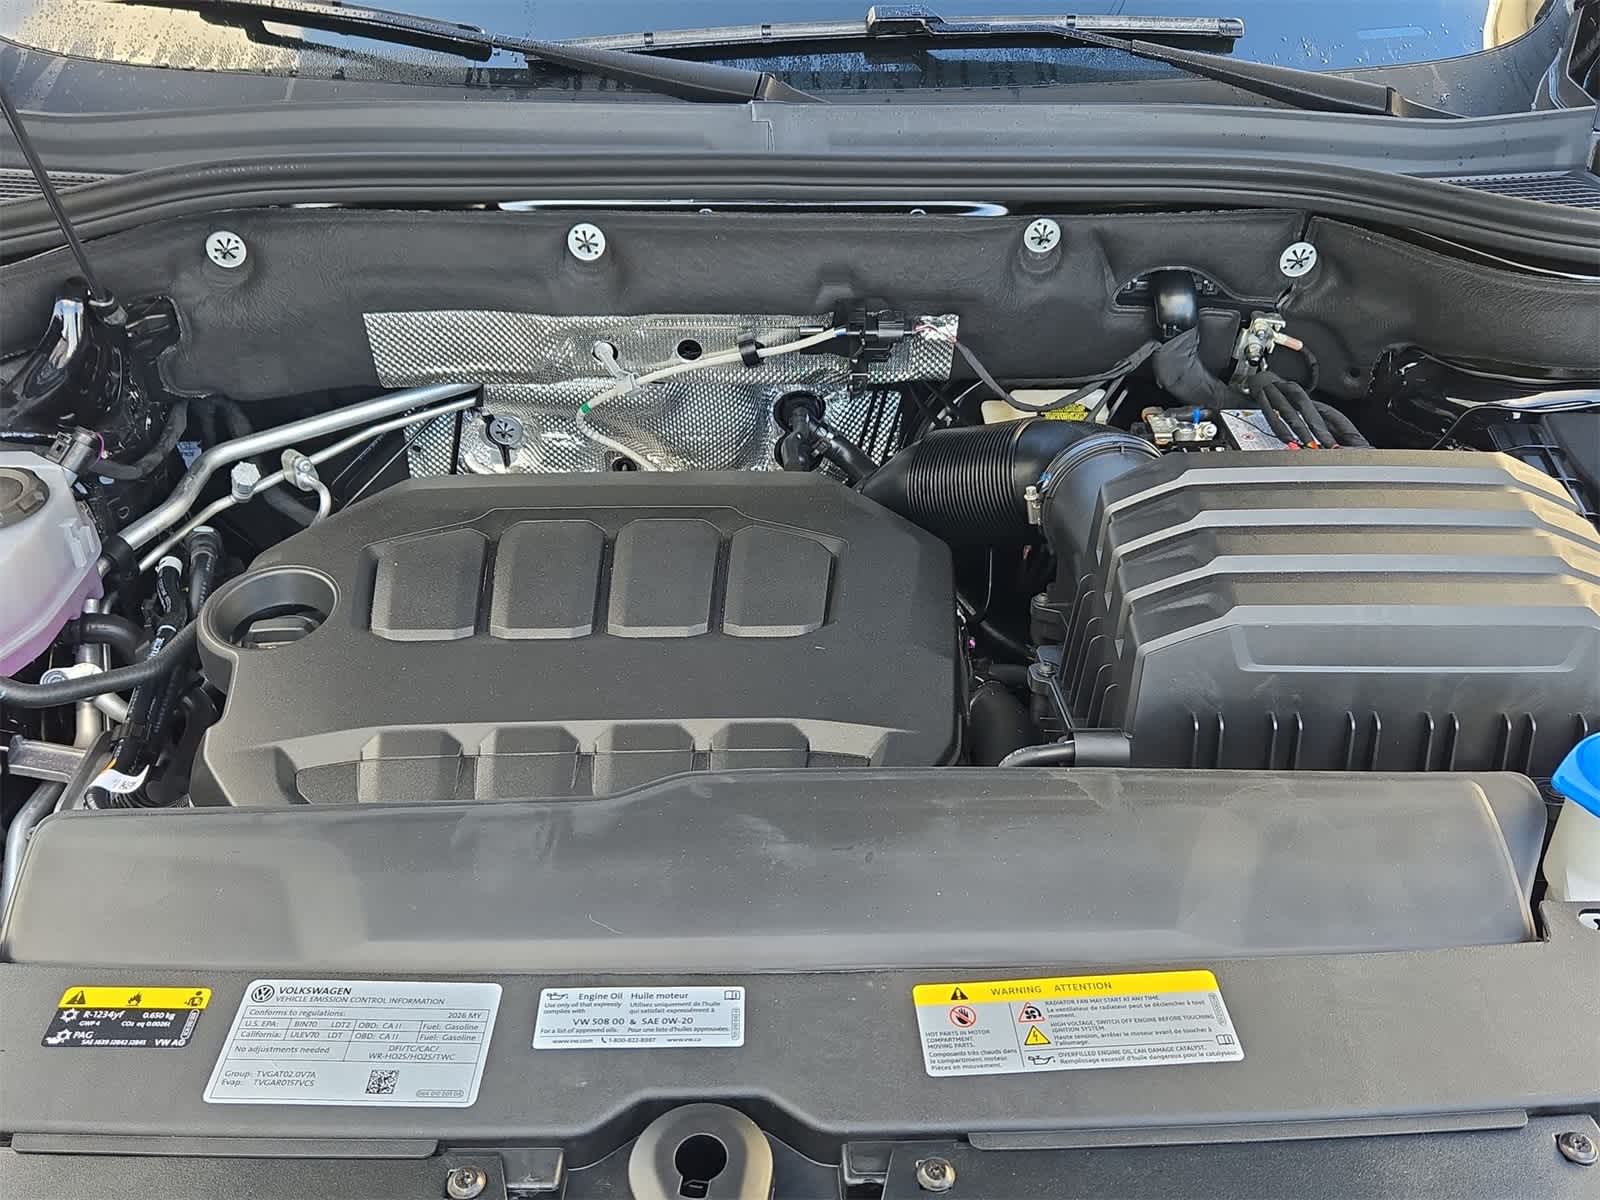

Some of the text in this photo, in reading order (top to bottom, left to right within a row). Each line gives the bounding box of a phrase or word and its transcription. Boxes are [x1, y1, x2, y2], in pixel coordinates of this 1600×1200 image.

[279, 986, 352, 995] VOLKSWAGEN
[990, 985, 1042, 996] WARNING
[1054, 981, 1112, 992] ATTENTION
[308, 995, 348, 1003] EMISSION
[350, 996, 389, 1004] CONTROL
[389, 997, 446, 1005] INFORMATION
[578, 992, 624, 1002] Engine Oil
[631, 992, 689, 1000] Huile moteur
[556, 1002, 570, 1010] only
[594, 1001, 623, 1009] expressly
[1055, 1005, 1089, 1013] ventilateur
[83, 1010, 126, 1020] R-1234yf
[142, 1011, 176, 1020] 0.650 kg
[248, 1008, 287, 1017] Conforms
[289, 1009, 298, 1017] to
[447, 1011, 467, 1019] 2026
[260, 1020, 279, 1028] EPA:
[294, 1020, 318, 1028] BIN70
[330, 1021, 351, 1029] LDT2
[572, 1017, 591, 1026] VW
[592, 1017, 610, 1026] 508
[611, 1017, 626, 1026] 00
[641, 1017, 660, 1025] SAE
[661, 1016, 694, 1025] 0W-20
[358, 1022, 379, 1030] OBD:
[382, 1022, 393, 1030] CA
[422, 1023, 479, 1031] Fuel: Gasoline
[567, 1026, 576, 1034] of
[73, 1031, 94, 1039] PAG
[240, 1030, 281, 1039] California:
[290, 1031, 321, 1039] ULEV70
[354, 1032, 376, 1040] OBD:
[419, 1033, 477, 1041] Fuel: Gasoline
[171, 1039, 187, 1047] AG
[247, 1046, 298, 1055] adjustments
[299, 1046, 330, 1054] needed
[928, 1051, 967, 1059] Composants
[979, 1048, 1002, 1056] chauds
[1058, 1050, 1097, 1058] OVERFILLED
[1147, 1046, 1174, 1054] DAMAGE
[937, 1056, 984, 1065] compartiment
[1060, 1057, 1100, 1065] Remplissage
[1100, 1056, 1126, 1064] excessif
